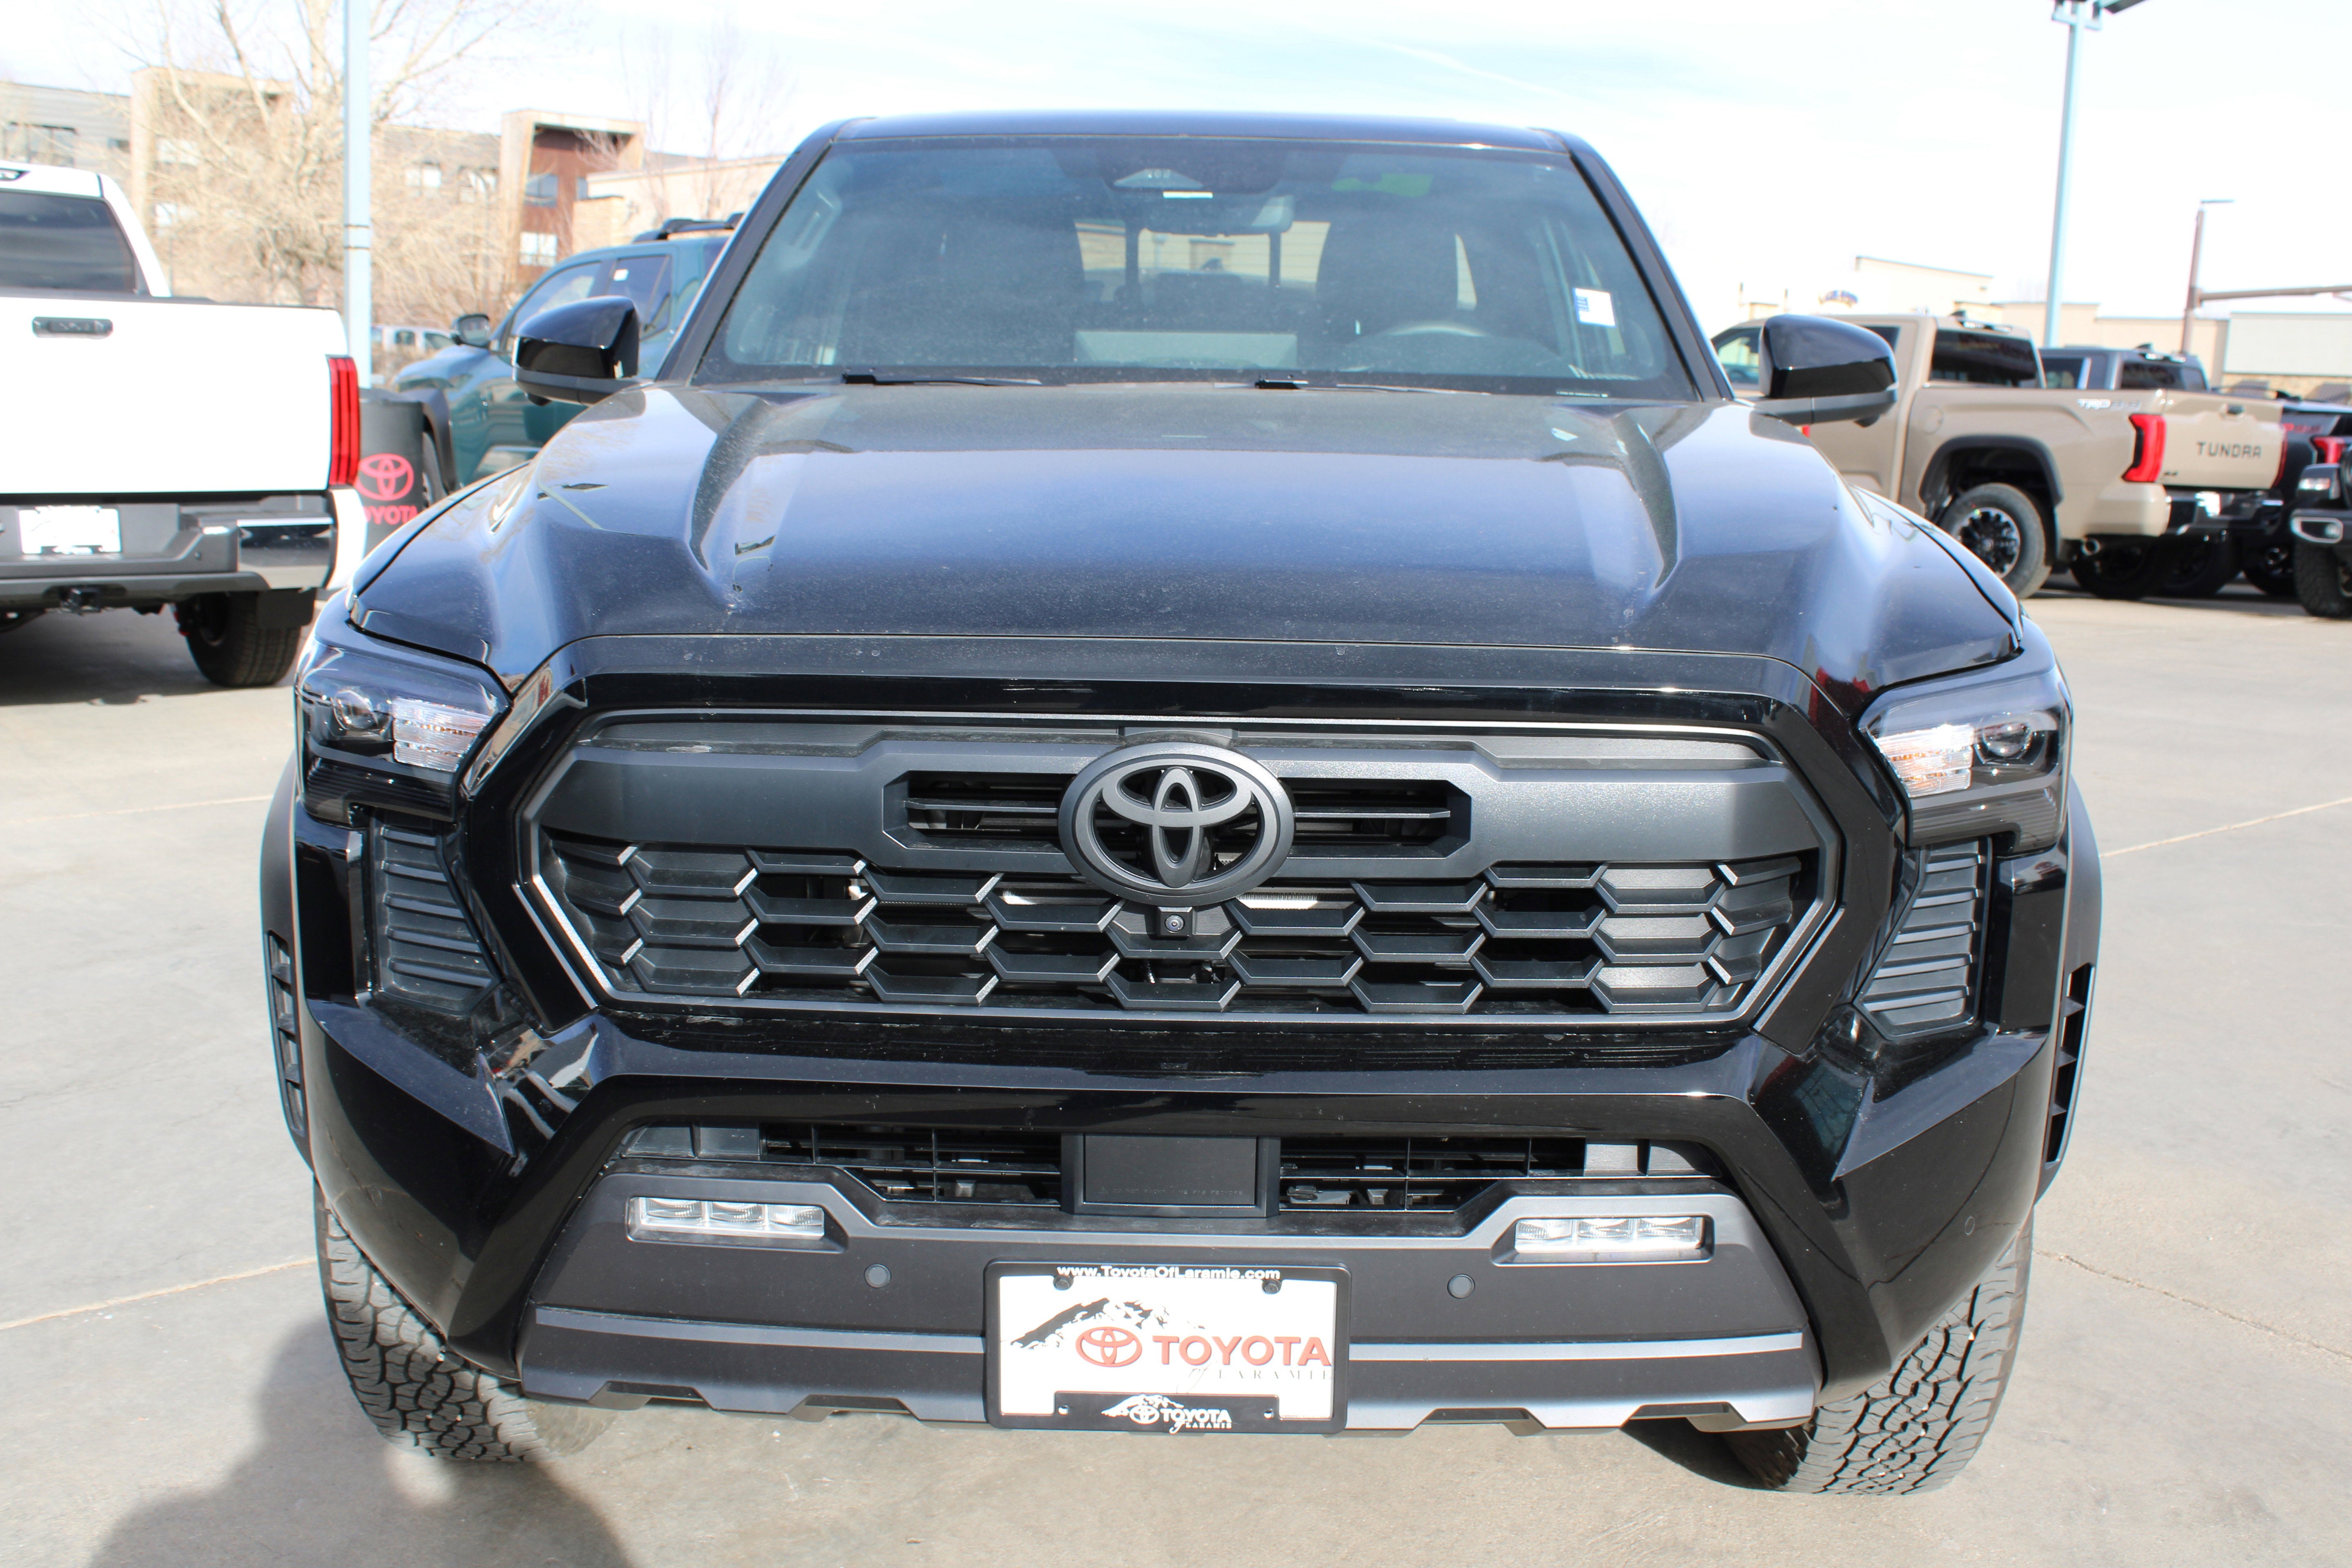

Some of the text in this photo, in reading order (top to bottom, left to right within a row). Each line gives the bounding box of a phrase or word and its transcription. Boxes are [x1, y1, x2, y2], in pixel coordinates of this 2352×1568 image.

[2196, 441, 2262, 458] TUNDRA
[1056, 1265, 1281, 1280] www.ToyotaOfLaramie.com
[1152, 1335, 1332, 1366] TOYOTA
[1160, 1408, 1232, 1423] TOYOTA
